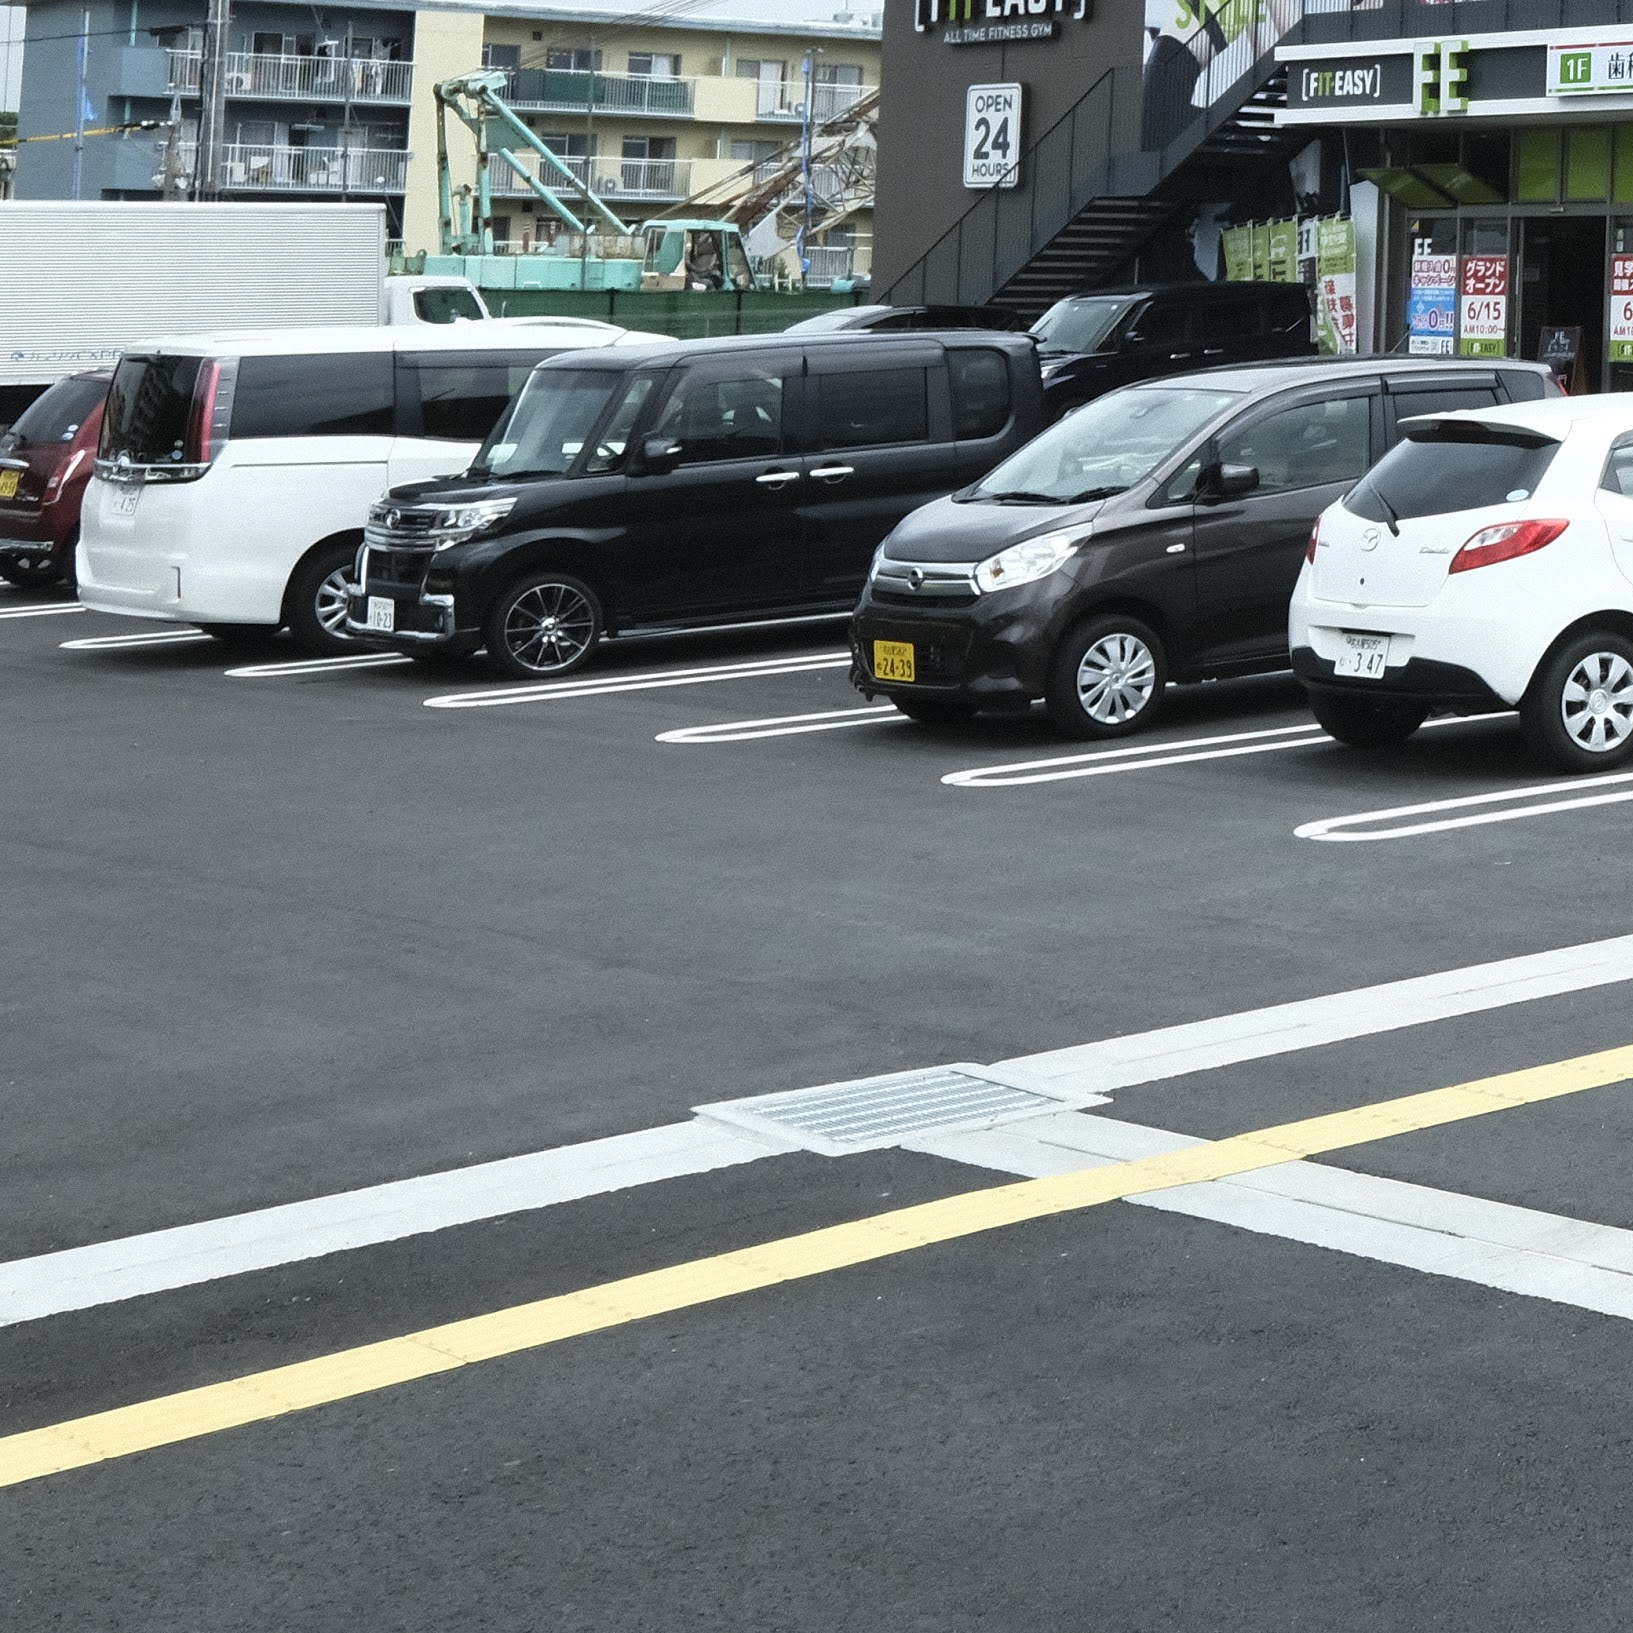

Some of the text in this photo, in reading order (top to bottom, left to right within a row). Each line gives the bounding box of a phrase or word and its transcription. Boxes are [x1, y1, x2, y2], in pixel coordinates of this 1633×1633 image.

[943, 22, 1053, 44] ALL TIME FITNESS GYM
[1566, 57, 1588, 81] 1F
[974, 94, 1013, 113] OPEN
[972, 117, 1011, 160] 24
[971, 162, 1011, 178] HOURS
[1466, 260, 1504, 277] グランド
[1465, 278, 1504, 294] オープン
[1467, 301, 1501, 321] 6/15
